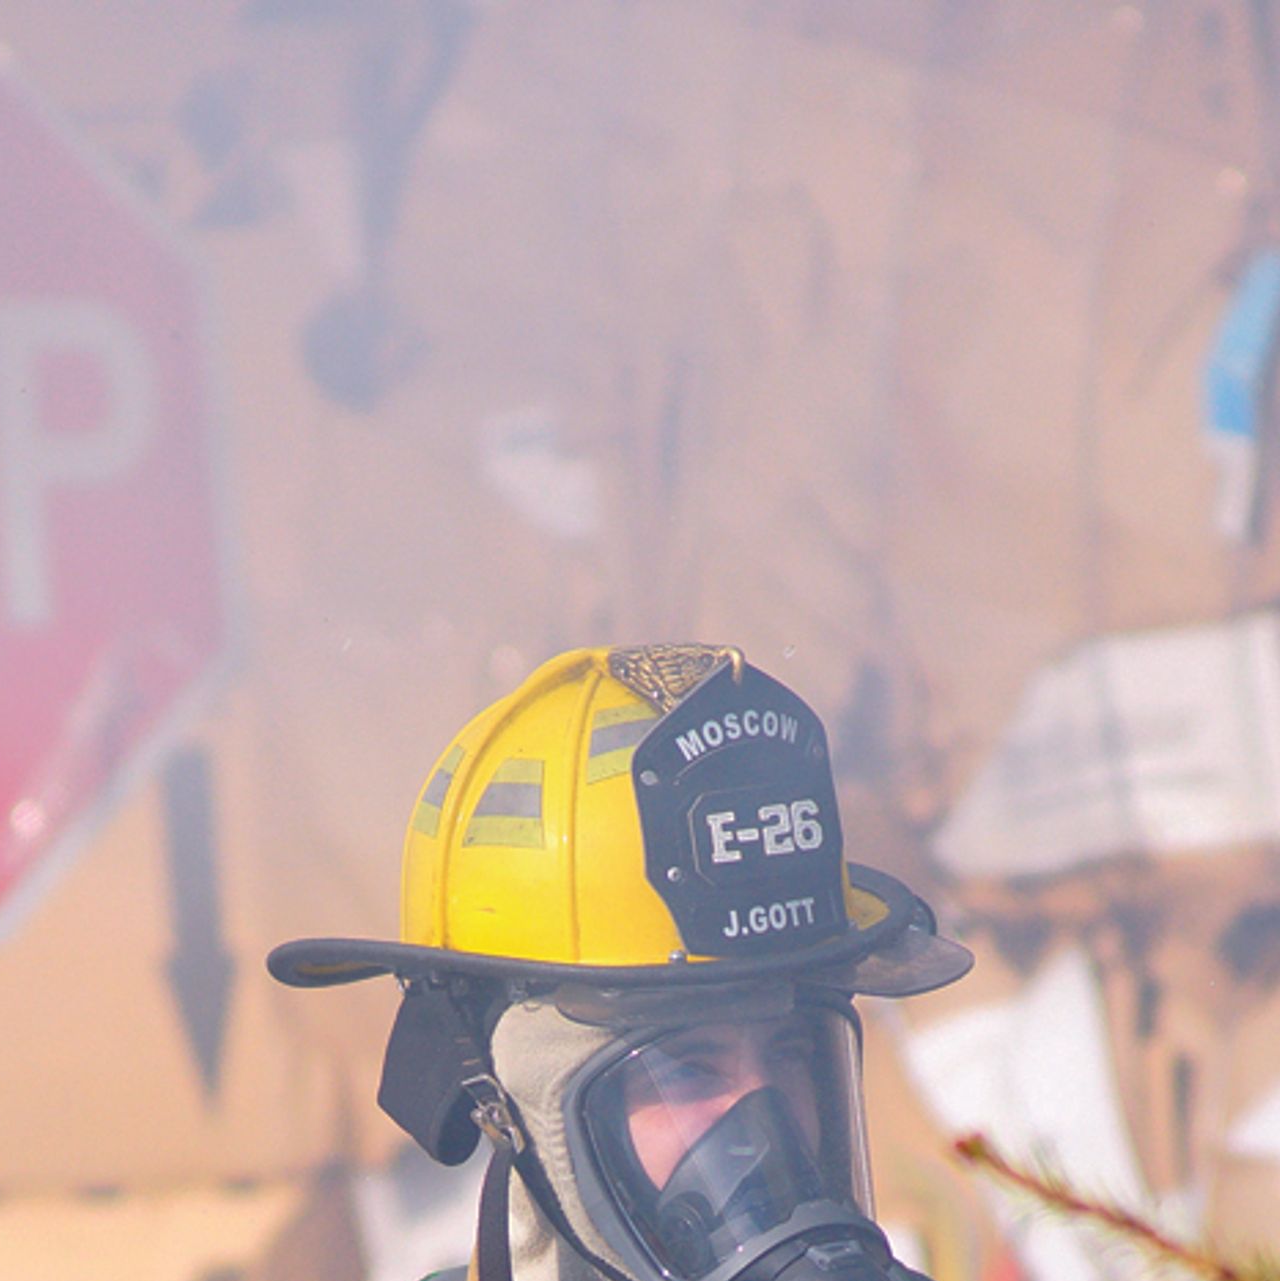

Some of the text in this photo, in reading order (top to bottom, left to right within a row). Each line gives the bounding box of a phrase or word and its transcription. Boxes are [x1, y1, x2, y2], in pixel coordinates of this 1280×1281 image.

[675, 710, 798, 761] MOSCOW
[706, 800, 823, 864] E-26
[723, 898, 814, 938] J.GOTT
